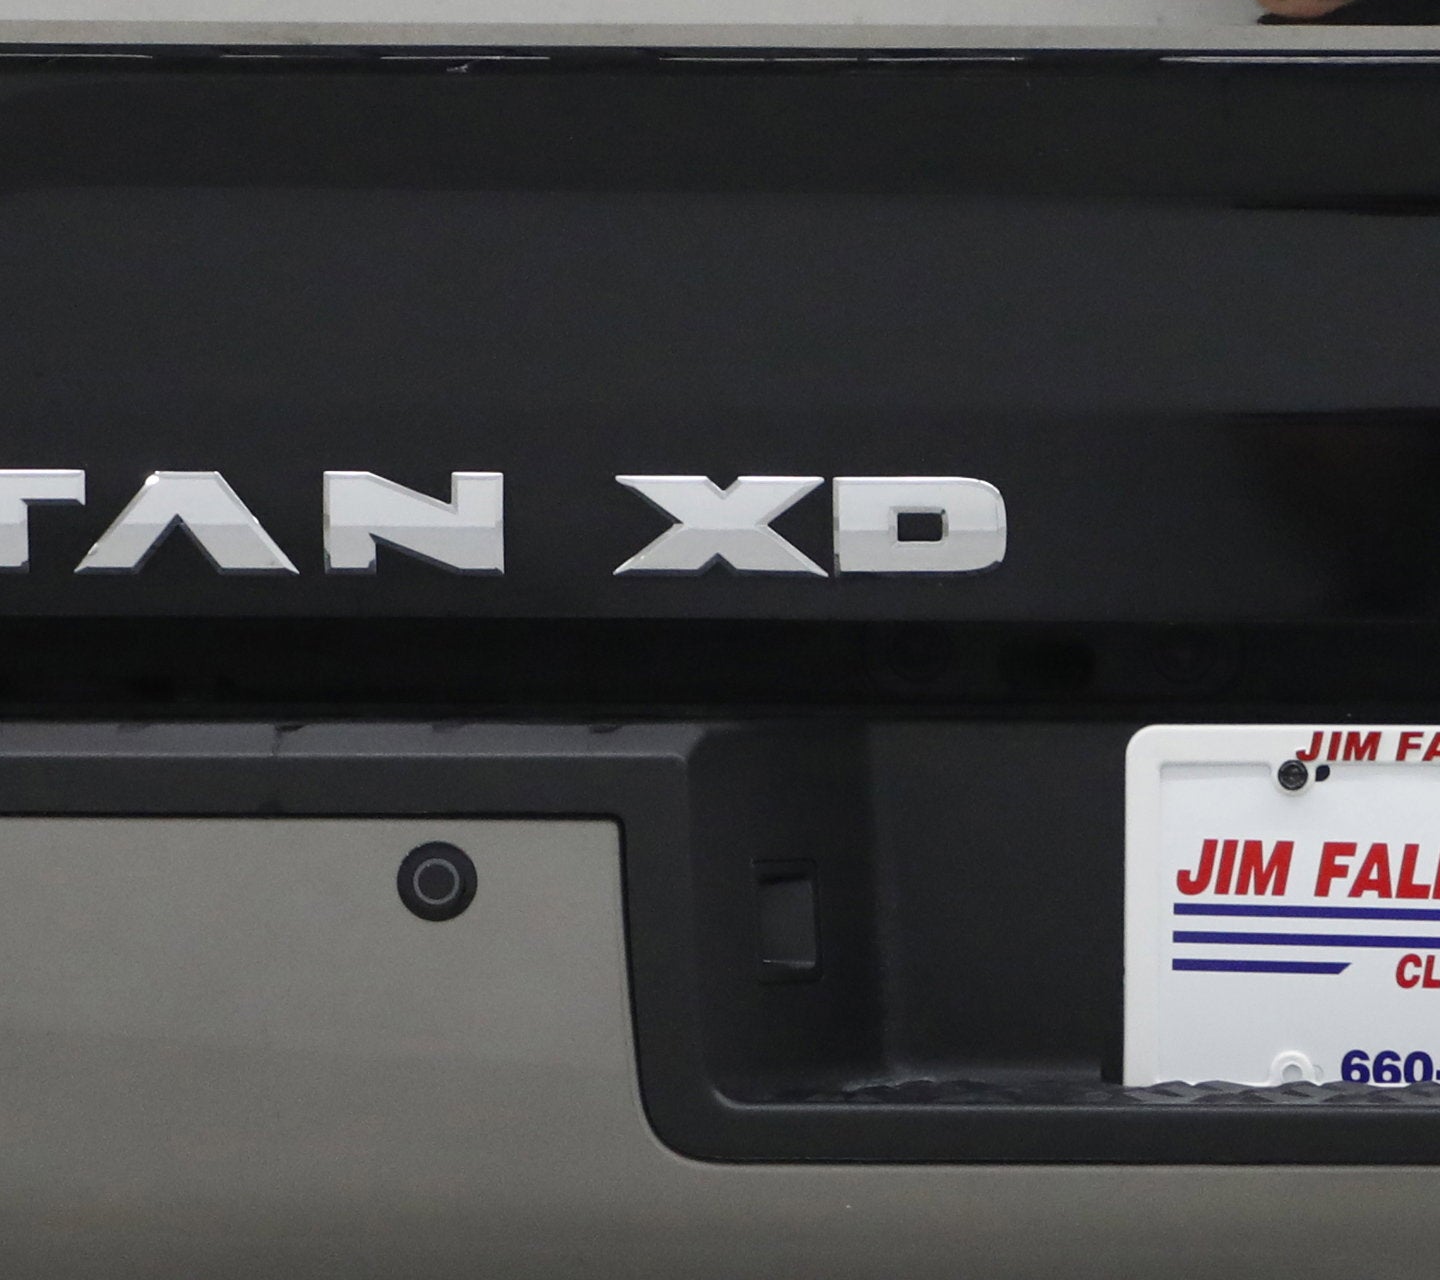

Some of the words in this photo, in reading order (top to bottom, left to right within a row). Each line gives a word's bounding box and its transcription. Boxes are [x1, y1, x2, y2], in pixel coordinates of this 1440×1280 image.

[611, 474, 1010, 577] XD
[1296, 730, 1381, 763] JIM
[1176, 838, 1295, 897] JIM
